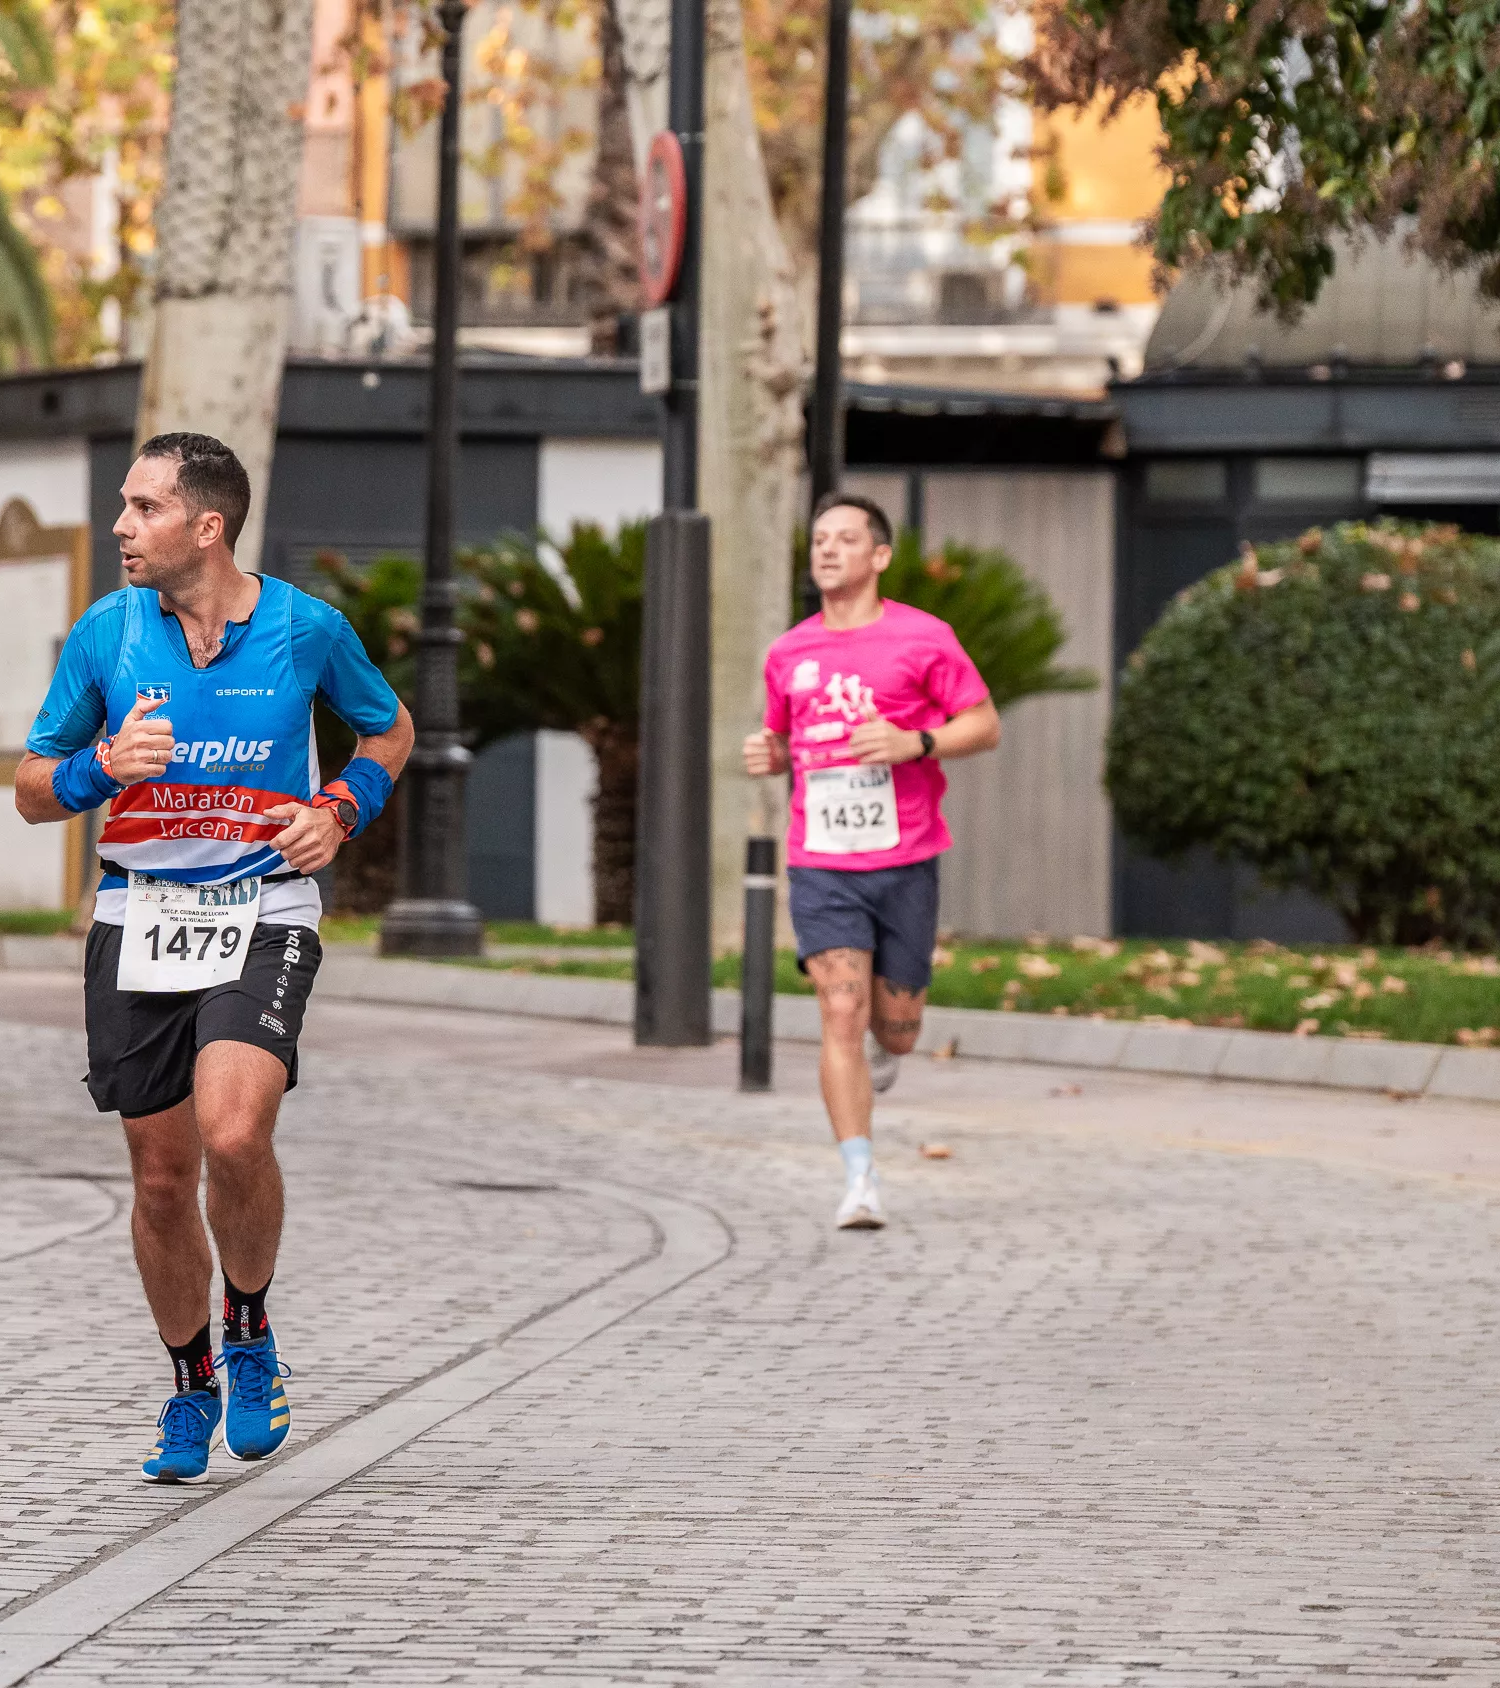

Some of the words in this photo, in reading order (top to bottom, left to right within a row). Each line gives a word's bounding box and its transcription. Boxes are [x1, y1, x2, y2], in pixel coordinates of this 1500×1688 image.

[206, 762, 265, 773] directo
[152, 787, 254, 813] Maratón
[821, 802, 886, 832] 1432
[160, 820, 244, 841] Lucena
[145, 924, 242, 961] 1479
